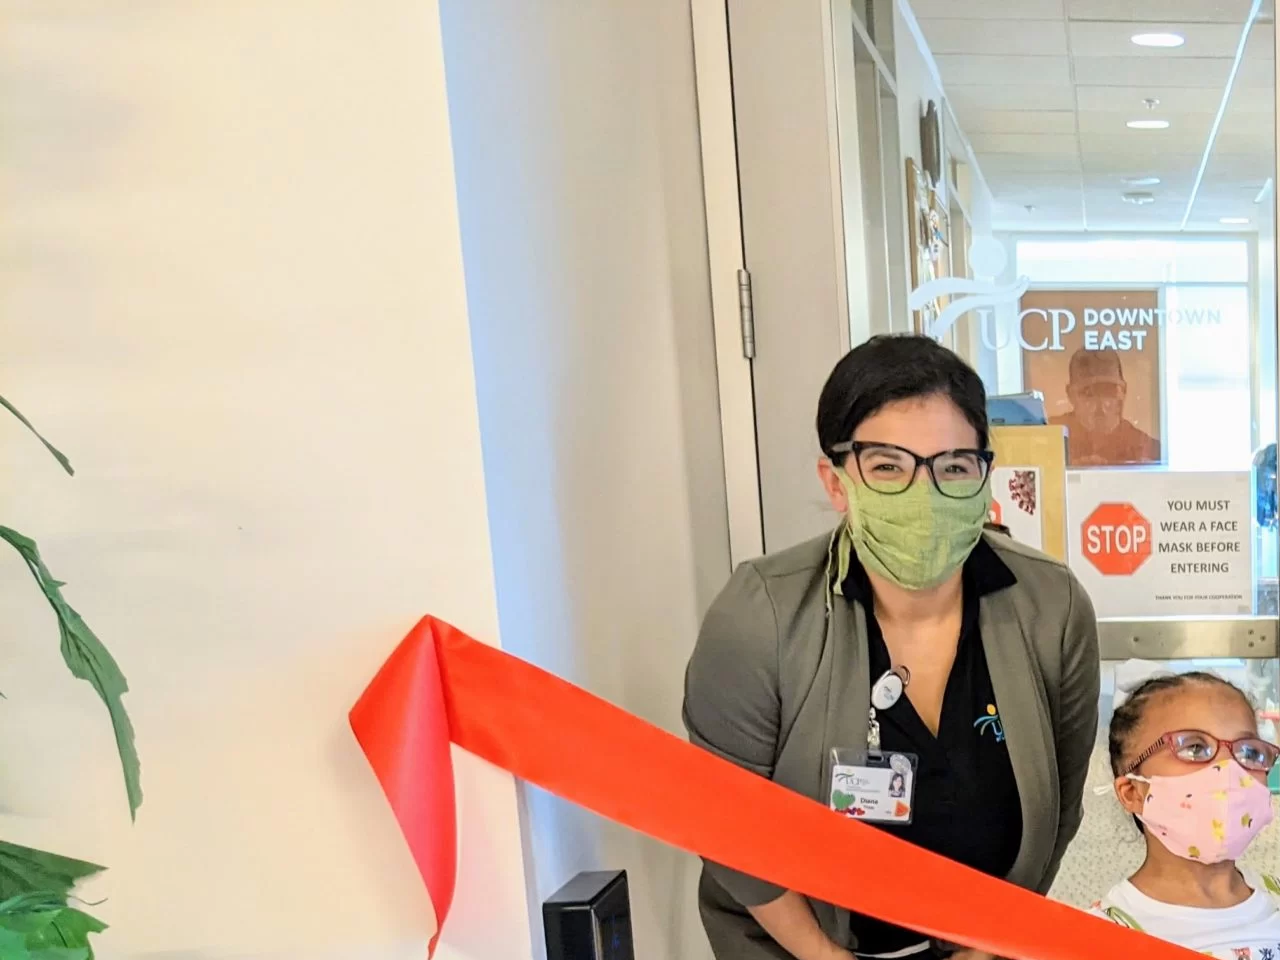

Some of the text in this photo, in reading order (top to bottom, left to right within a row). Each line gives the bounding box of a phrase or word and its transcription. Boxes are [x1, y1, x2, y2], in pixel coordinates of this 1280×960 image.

[977, 308, 1221, 351] UCP DOWNTOWN
[1084, 331, 1147, 350] EAST
[1167, 500, 1230, 511] YOU MUST
[1160, 521, 1238, 532] WEAR A FACE
[1087, 525, 1146, 554] STOP
[1158, 541, 1241, 553] MASK BEFORE
[1170, 562, 1229, 574] ENTERING
